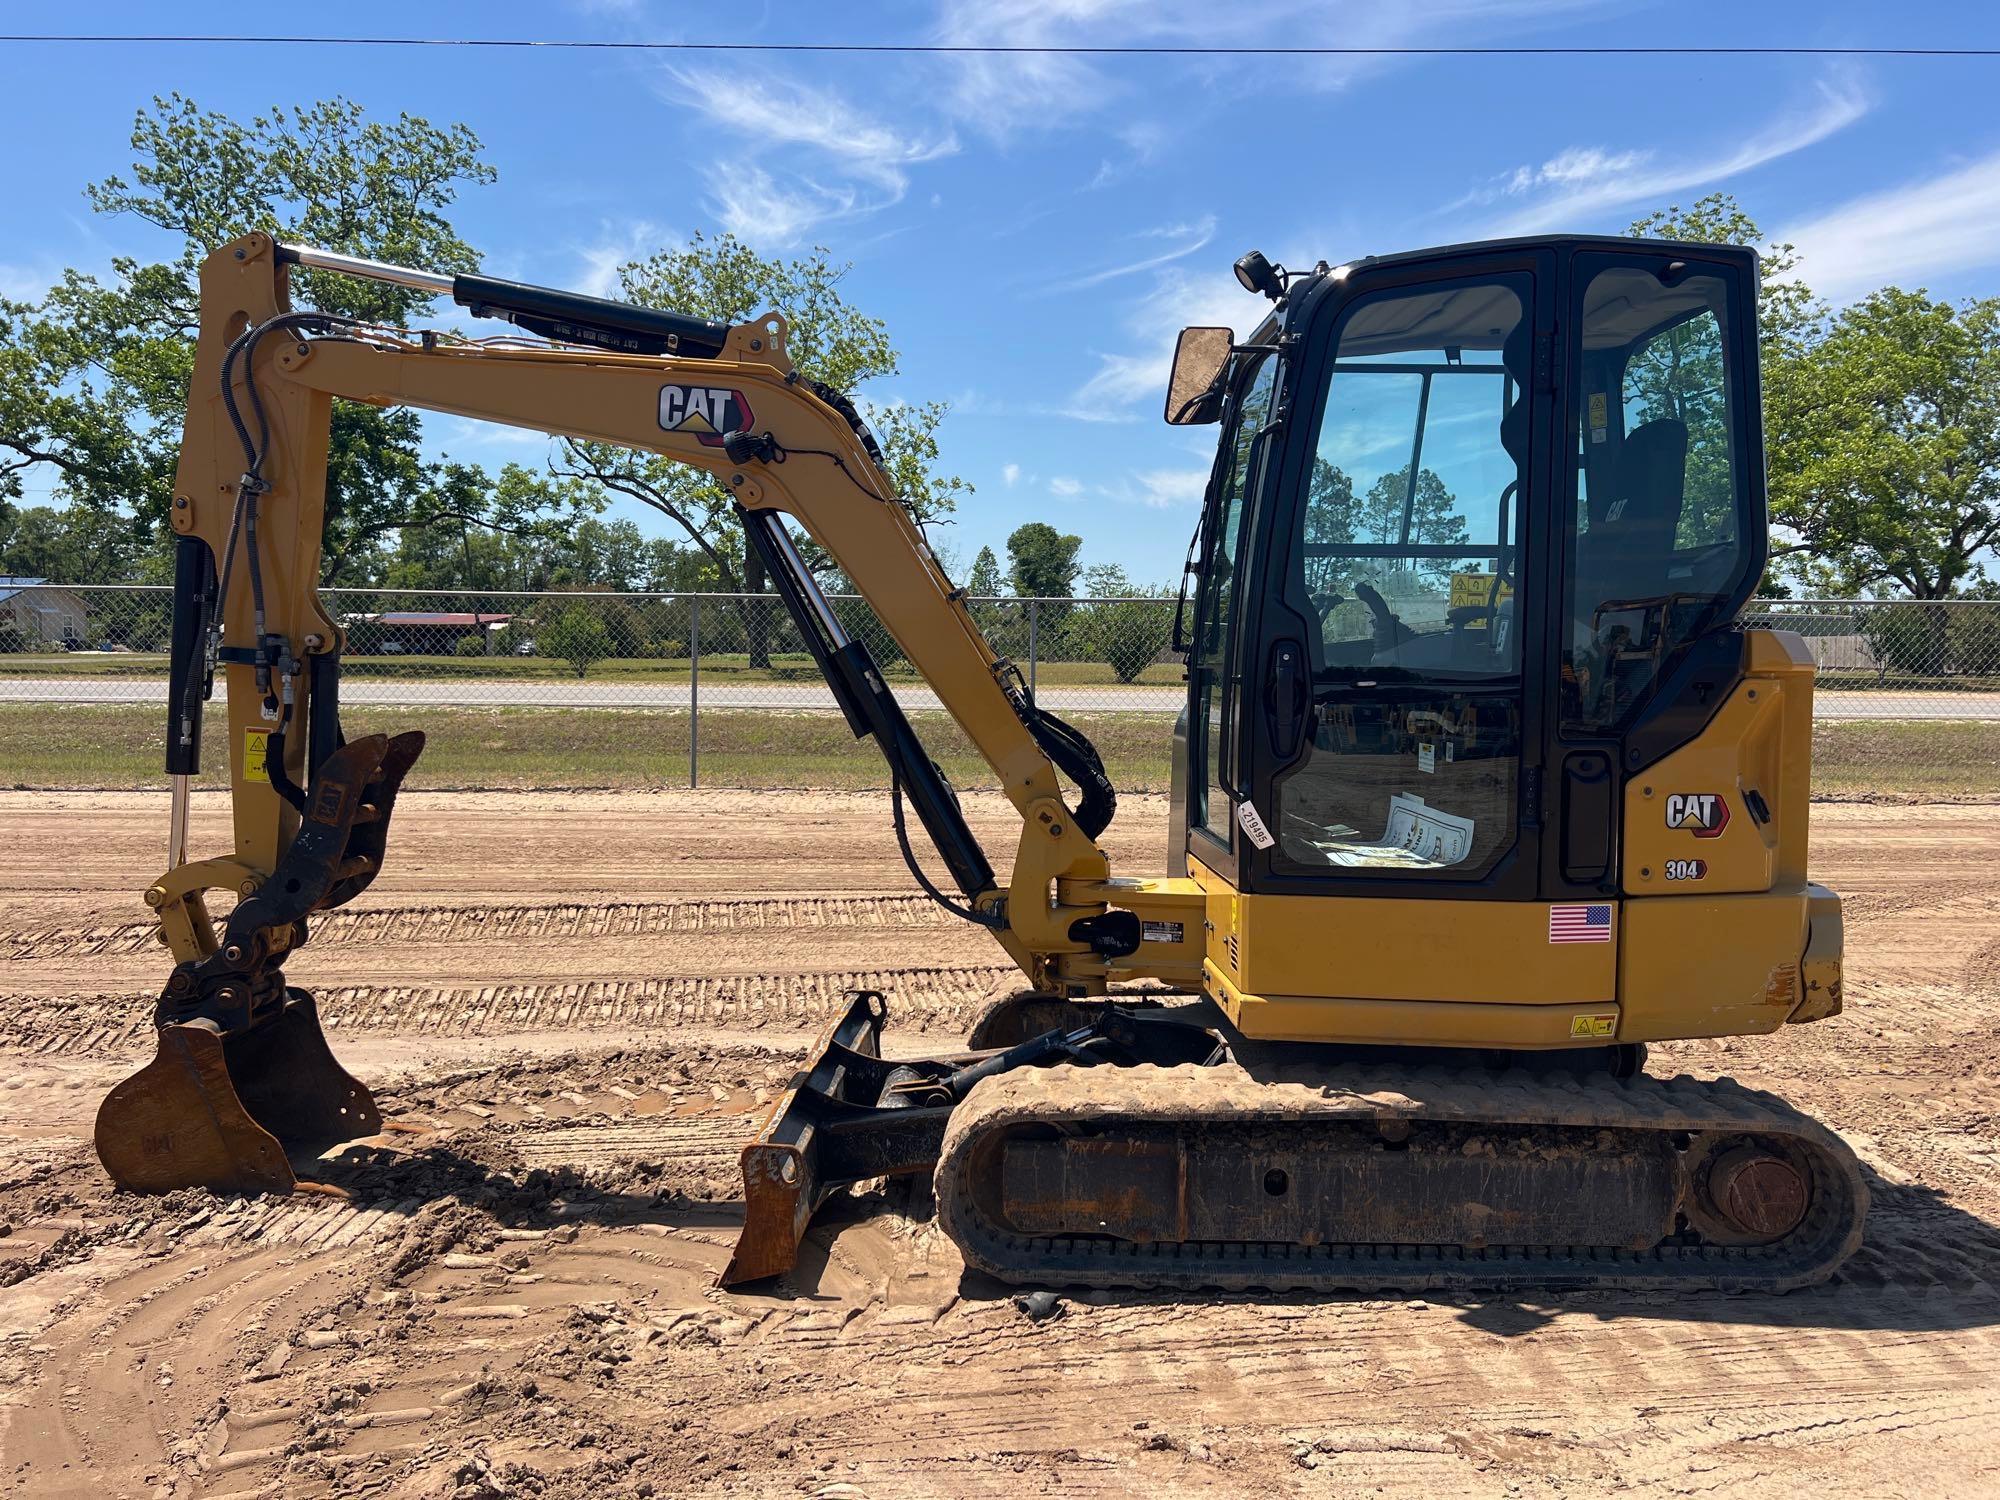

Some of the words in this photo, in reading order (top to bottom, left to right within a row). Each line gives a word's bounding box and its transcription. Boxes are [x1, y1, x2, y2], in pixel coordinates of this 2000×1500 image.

[660, 385, 732, 433] CAT
[1243, 811, 1268, 843] 219495
[1667, 795, 1715, 828] CAT
[1666, 860, 1698, 880] 304
